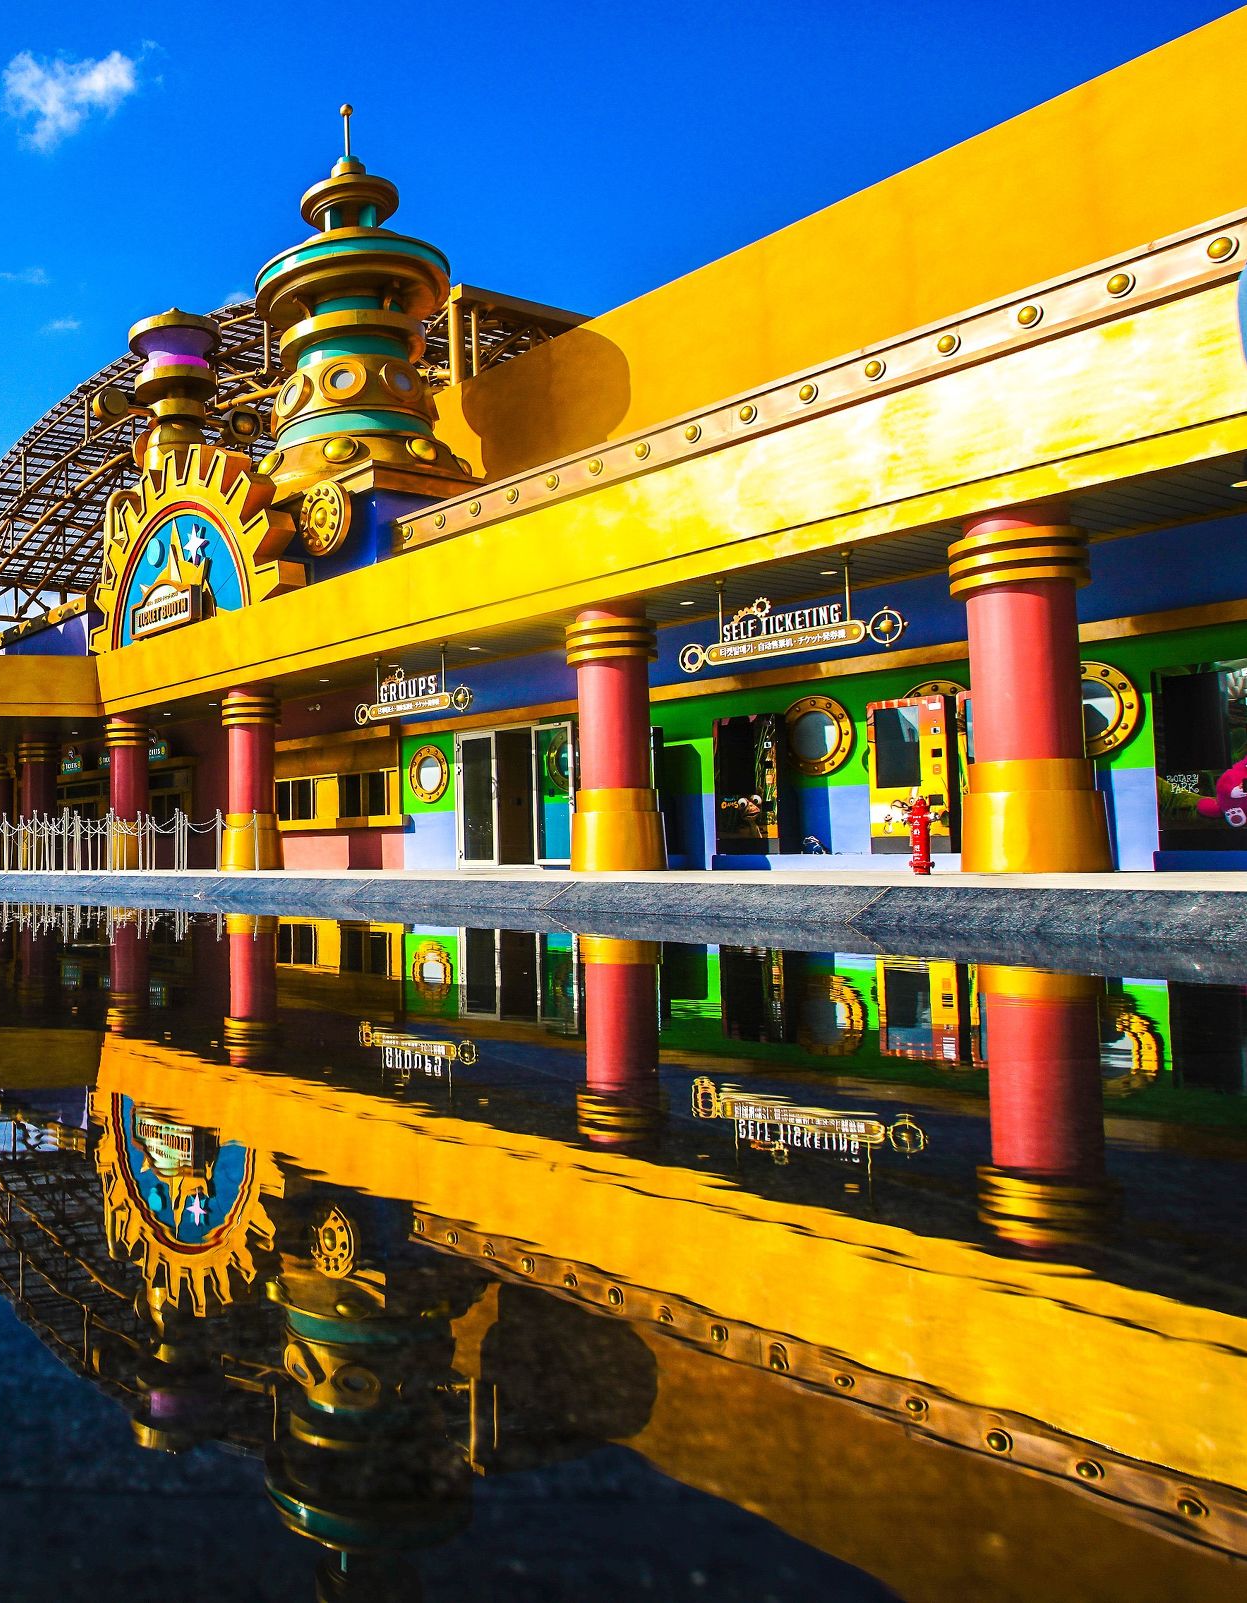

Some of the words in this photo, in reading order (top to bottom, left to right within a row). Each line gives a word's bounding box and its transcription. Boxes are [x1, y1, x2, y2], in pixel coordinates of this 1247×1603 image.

[723, 618, 757, 642] SELF
[761, 603, 842, 635] TICKETING
[380, 674, 438, 703] GROUPS
[1166, 773, 1199, 785] ROTARY
[1170, 782, 1199, 794] PARK
